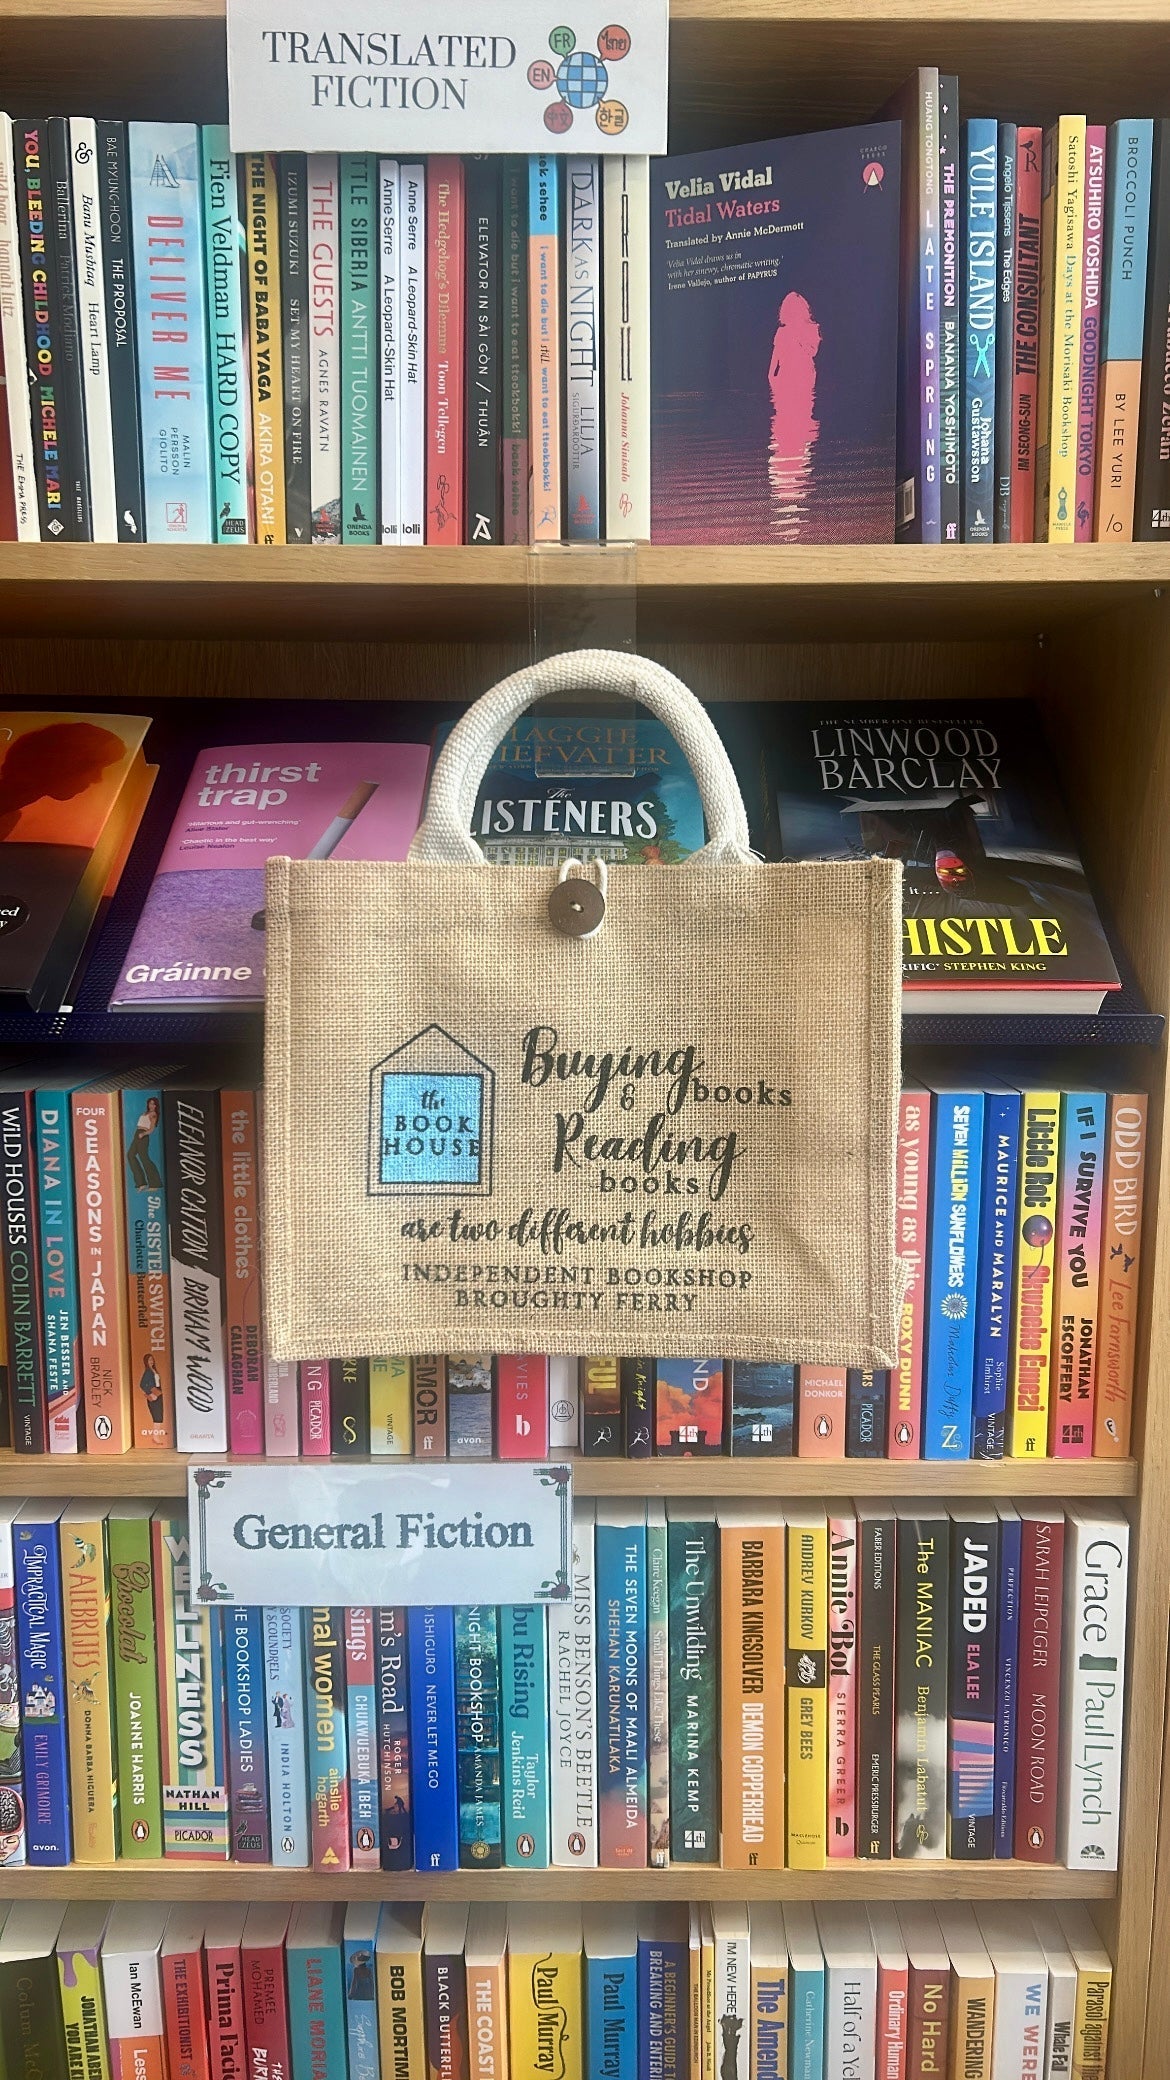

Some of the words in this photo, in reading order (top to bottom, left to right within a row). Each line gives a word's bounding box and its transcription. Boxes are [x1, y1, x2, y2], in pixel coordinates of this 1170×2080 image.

[262, 31, 516, 69] TRANSLATED
[555, 34, 570, 47] FR
[312, 74, 468, 110] FICTION
[533, 68, 550, 81] EN
[600, 109, 624, 127] 한글
[210, 159, 230, 210] Fien
[665, 177, 714, 200] Velia
[719, 166, 773, 192] Vidal
[943, 163, 954, 195] THE
[969, 144, 996, 219] YULE
[1087, 144, 1104, 230] ATSUHIRO
[1124, 137, 1138, 220] BROCCOLI
[26, 178, 46, 265] BLEEDING
[252, 194, 266, 260] NIGHT
[313, 181, 332, 230] THE
[665, 204, 711, 228] Tidal
[716, 199, 780, 220] Waters
[351, 218, 368, 292] SIBERIA
[665, 235, 709, 249] Translated
[711, 234, 723, 243] by
[725, 229, 751, 240] Annie
[754, 222, 804, 236] McDermott
[943, 199, 955, 307] PREMONITION
[1122, 225, 1135, 281] PUNCH
[111, 258, 124, 280] THE
[148, 216, 188, 344] DELIVER
[212, 215, 233, 319] Veldman
[254, 260, 268, 286] OF
[312, 244, 334, 336] GUESTS
[969, 230, 994, 330] ISLAND
[1016, 214, 1039, 337] CONSULTANT
[1086, 232, 1102, 309] YOSHIDA
[32, 269, 53, 376] CHILDHOOD
[113, 283, 127, 347] PROPOSAL
[255, 292, 269, 344] BABA
[351, 300, 368, 359] ANTTI
[216, 332, 238, 407] HARD
[257, 350, 271, 402] YAGA
[319, 350, 329, 394] AGNES
[944, 322, 955, 390] BANANA
[1016, 340, 1037, 376] THE
[1081, 317, 1098, 418] GOODNIGHT
[154, 366, 190, 400] ME
[1116, 393, 1126, 412] BY
[40, 386, 59, 461] MICHELE
[219, 413, 240, 484] COPY
[259, 413, 272, 467] AKIRA
[319, 401, 329, 451] RAVATN
[351, 368, 368, 491] TUOMAINEN
[945, 393, 956, 485] YOSHIMOTO
[1113, 419, 1124, 446] LEE
[1079, 424, 1093, 476] TOKYO
[1111, 454, 1122, 488] YURI
[44, 465, 61, 509] MARI
[260, 471, 275, 525] OTANI
[811, 726, 1000, 760] LINWOOD
[197, 784, 288, 809] trap
[204, 762, 323, 785] thirst
[818, 757, 1001, 794] BARCLAY
[125, 961, 253, 985] Gráinne
[943, 961, 1005, 972] STEPHEN
[1010, 961, 1047, 972] KING
[522, 1025, 706, 1115] Buying
[692, 1080, 793, 1106] books
[395, 1116, 473, 1133] BOOK
[420, 1090, 445, 1110] the
[1076, 1106, 1093, 1121] IF
[41, 1109, 60, 1189] DIANA
[383, 1140, 480, 1157] HOUSE
[553, 1112, 747, 1201] Reading
[1080, 1132, 1096, 1140] I
[1114, 1107, 1142, 1169] ODD
[84, 1120, 102, 1242] SEASONS
[600, 1170, 700, 1195] books
[994, 1135, 1009, 1217] MAURICE
[1068, 1152, 1096, 1237] SURVIVE
[5, 1162, 27, 1244] HOUSES
[45, 1200, 62, 1225] IN
[1113, 1176, 1137, 1236] BIRD
[90, 1247, 101, 1255] IN
[401, 1220, 441, 1241] are
[447, 1209, 503, 1241] two
[508, 1208, 636, 1255] different
[639, 1211, 754, 1254] hobbies
[995, 1221, 1004, 1247] AND
[9, 1251, 31, 1317] COLIN
[46, 1237, 64, 1299] LOVE
[402, 1265, 595, 1285] INDEPENDENT
[606, 1270, 753, 1289] BOOKSHOP
[1068, 1244, 1089, 1288] YOU
[91, 1261, 108, 1347] JAPAN
[183, 1277, 210, 1348] BIRNAM
[456, 1290, 602, 1309] BROUGHTY
[617, 1294, 697, 1312] FERRY
[989, 1253, 1007, 1338] MARALYN
[14, 1322, 35, 1407] BARRETT
[184, 1351, 213, 1413] WOOD
[1058, 1315, 1074, 1402] ESCOFFERY
[1077, 1317, 1092, 1399] JONATHAN
[805, 1390, 843, 1398] DONKOR
[233, 1513, 385, 1550] General
[396, 1512, 534, 1549] Fiction
[626, 1545, 637, 1571] THE
[685, 1539, 704, 1578] The
[742, 1540, 764, 1606] BARBARA
[801, 1534, 813, 1585] ANDREY
[574, 1574, 590, 1625] MISS
[626, 1577, 637, 1624] SEVEN
[963, 1537, 987, 1633] JADED
[1083, 1540, 1123, 1642] Grace
[681, 1585, 706, 1680] Unwilding
[800, 1591, 813, 1640] KURKOV
[235, 1628, 251, 1714] BOOKSHOP
[559, 1631, 571, 1704] RACHEL
[626, 1631, 638, 1684] MOONS
[742, 1611, 764, 1694] KINGSOLVER
[966, 1644, 981, 1671] ELA
[626, 1691, 638, 1710] OF
[966, 1675, 980, 1700] LEE
[1085, 1681, 1115, 1741] Paul
[130, 1692, 144, 1753] JOANNE
[238, 1719, 253, 1772] LADIES
[558, 1711, 572, 1769] JOYCE
[626, 1716, 638, 1761] MAALI
[685, 1696, 698, 1761] MARINA
[742, 1702, 764, 1751] DEMON
[1032, 1694, 1047, 1745] MOON
[130, 1758, 145, 1805] HARRIS
[166, 1789, 220, 1799] NATHAN
[577, 1745, 592, 1828] BEETLE
[626, 1769, 638, 1828] ALMEIDA
[684, 1768, 699, 1813] KEMP
[742, 1755, 764, 1843] COPPERHEAD
[1030, 1749, 1045, 1803] ROAD
[1075, 1745, 1114, 1826] Lynch
[179, 1802, 210, 1811] HILL
[129, 1963, 139, 1981] Ian
[390, 1965, 406, 2001] BOB
[476, 1980, 491, 2013] THE
[536, 1967, 559, 2013] Paul
[130, 1984, 142, 2029] McEwan
[923, 1984, 942, 2014] No
[475, 2018, 494, 2074] COAST
[534, 2012, 558, 2074] Murray
[921, 2022, 941, 2073] Hard
